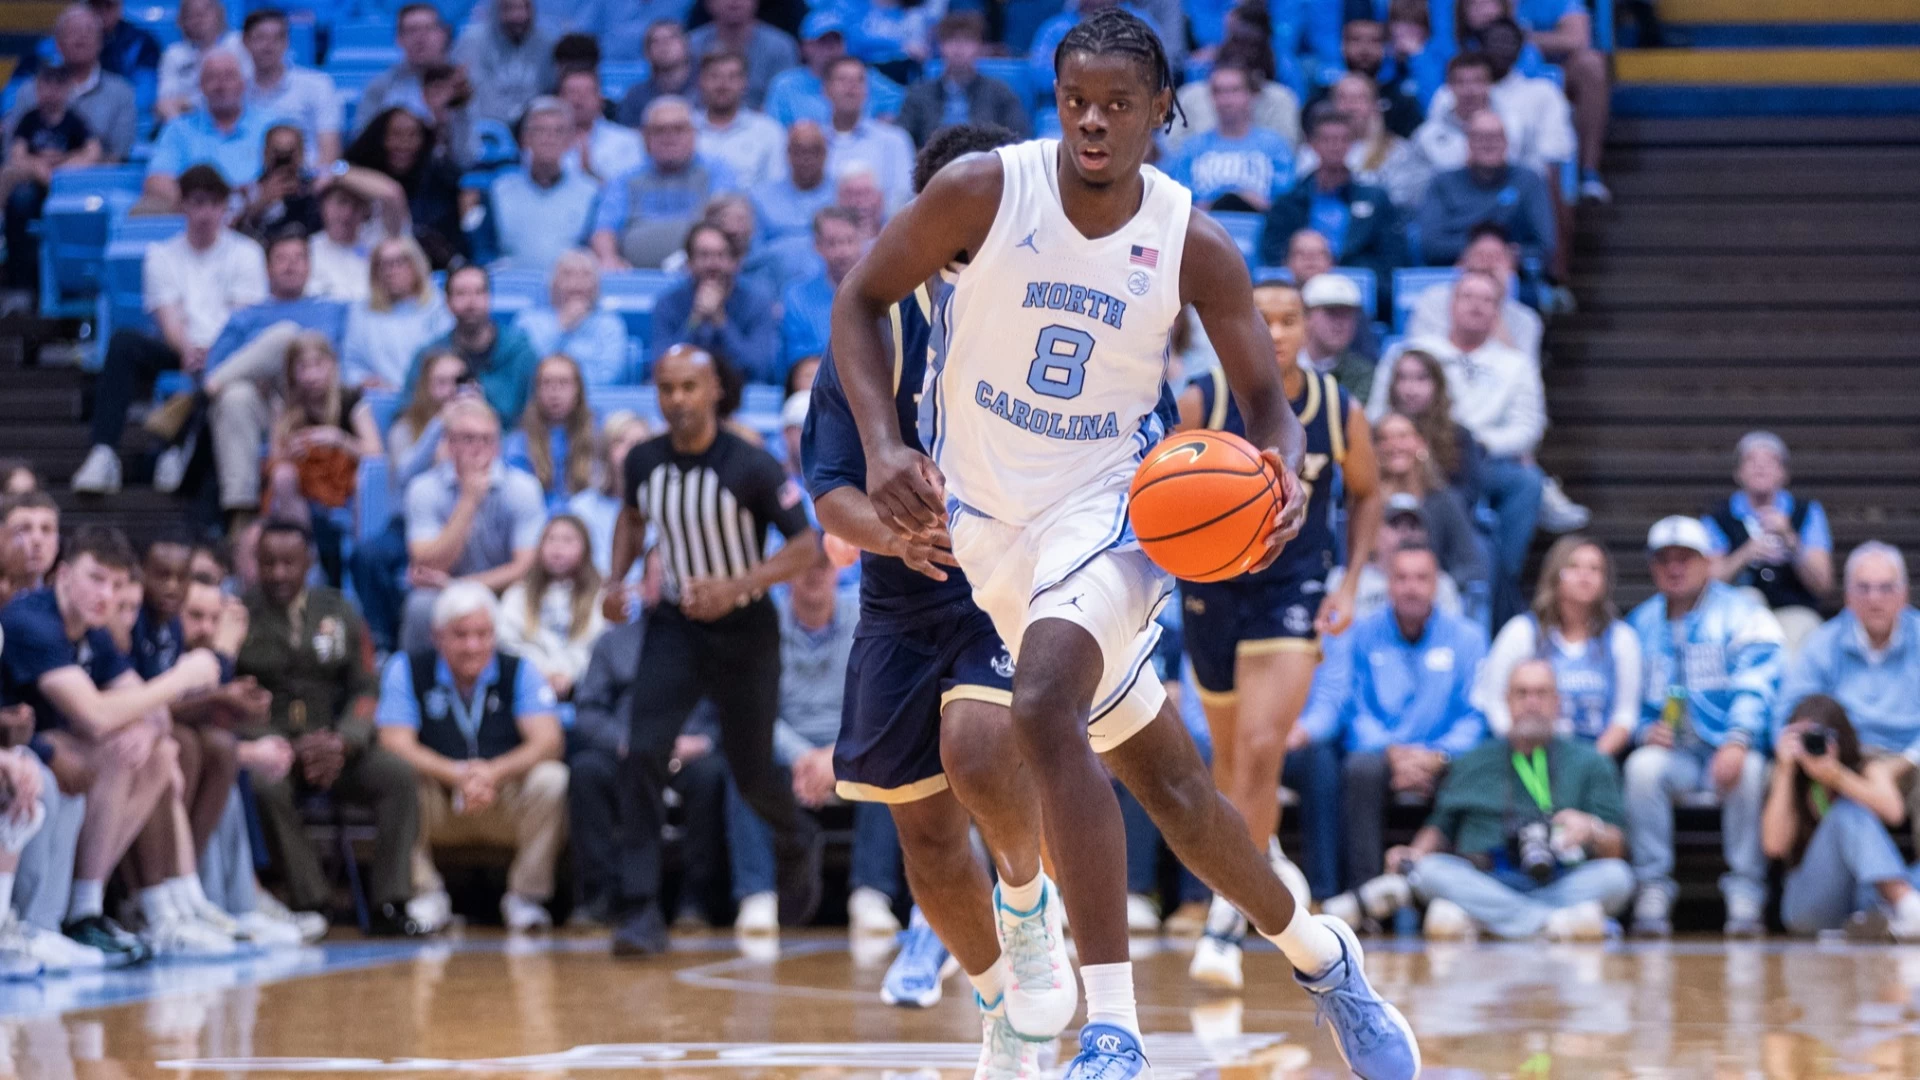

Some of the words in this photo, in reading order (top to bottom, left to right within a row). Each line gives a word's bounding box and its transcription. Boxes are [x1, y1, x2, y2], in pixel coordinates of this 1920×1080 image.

[1022, 282, 1127, 330] NORTH
[1026, 323, 1096, 400] 8
[975, 380, 1119, 441] CAROLINA
